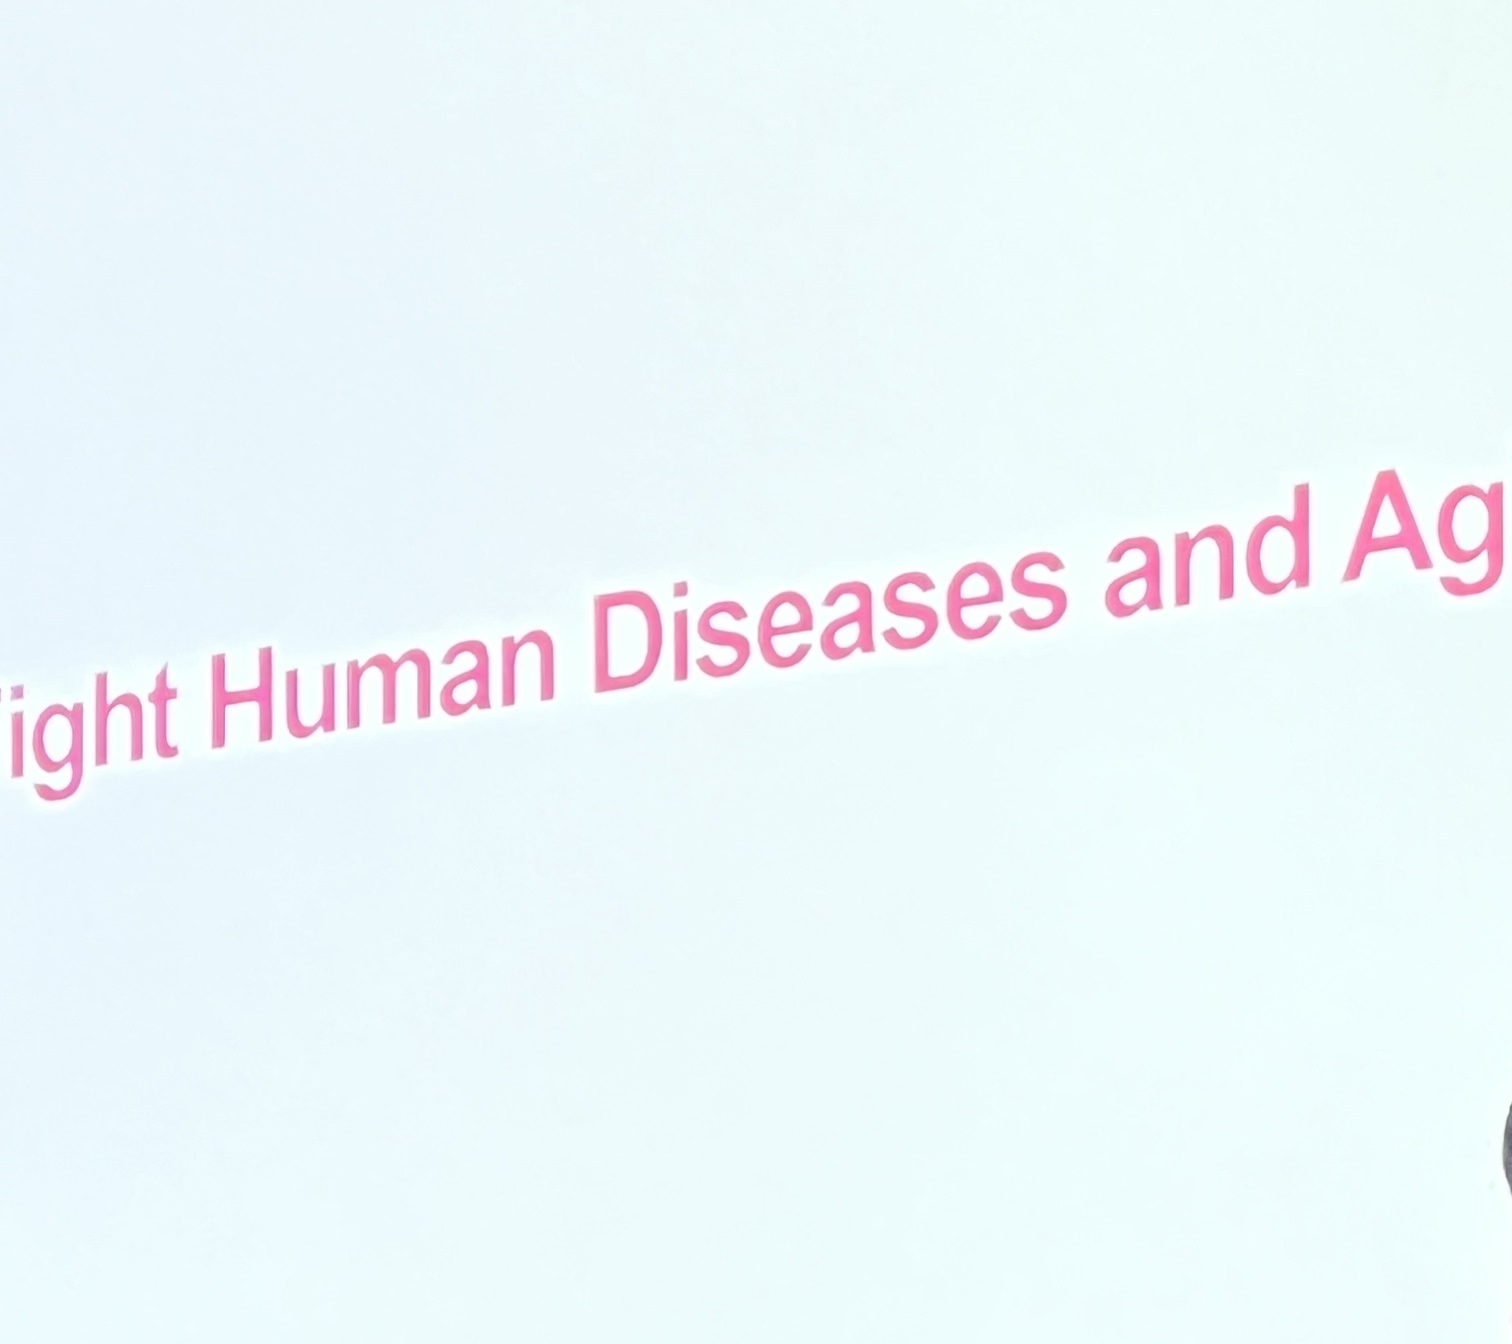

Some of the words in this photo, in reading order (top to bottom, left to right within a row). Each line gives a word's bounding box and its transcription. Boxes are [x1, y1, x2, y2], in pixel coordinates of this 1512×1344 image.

[0, 661, 180, 801] ight
[211, 629, 555, 749] Human
[594, 552, 1069, 693] Diseases
[1105, 485, 1310, 618] and
